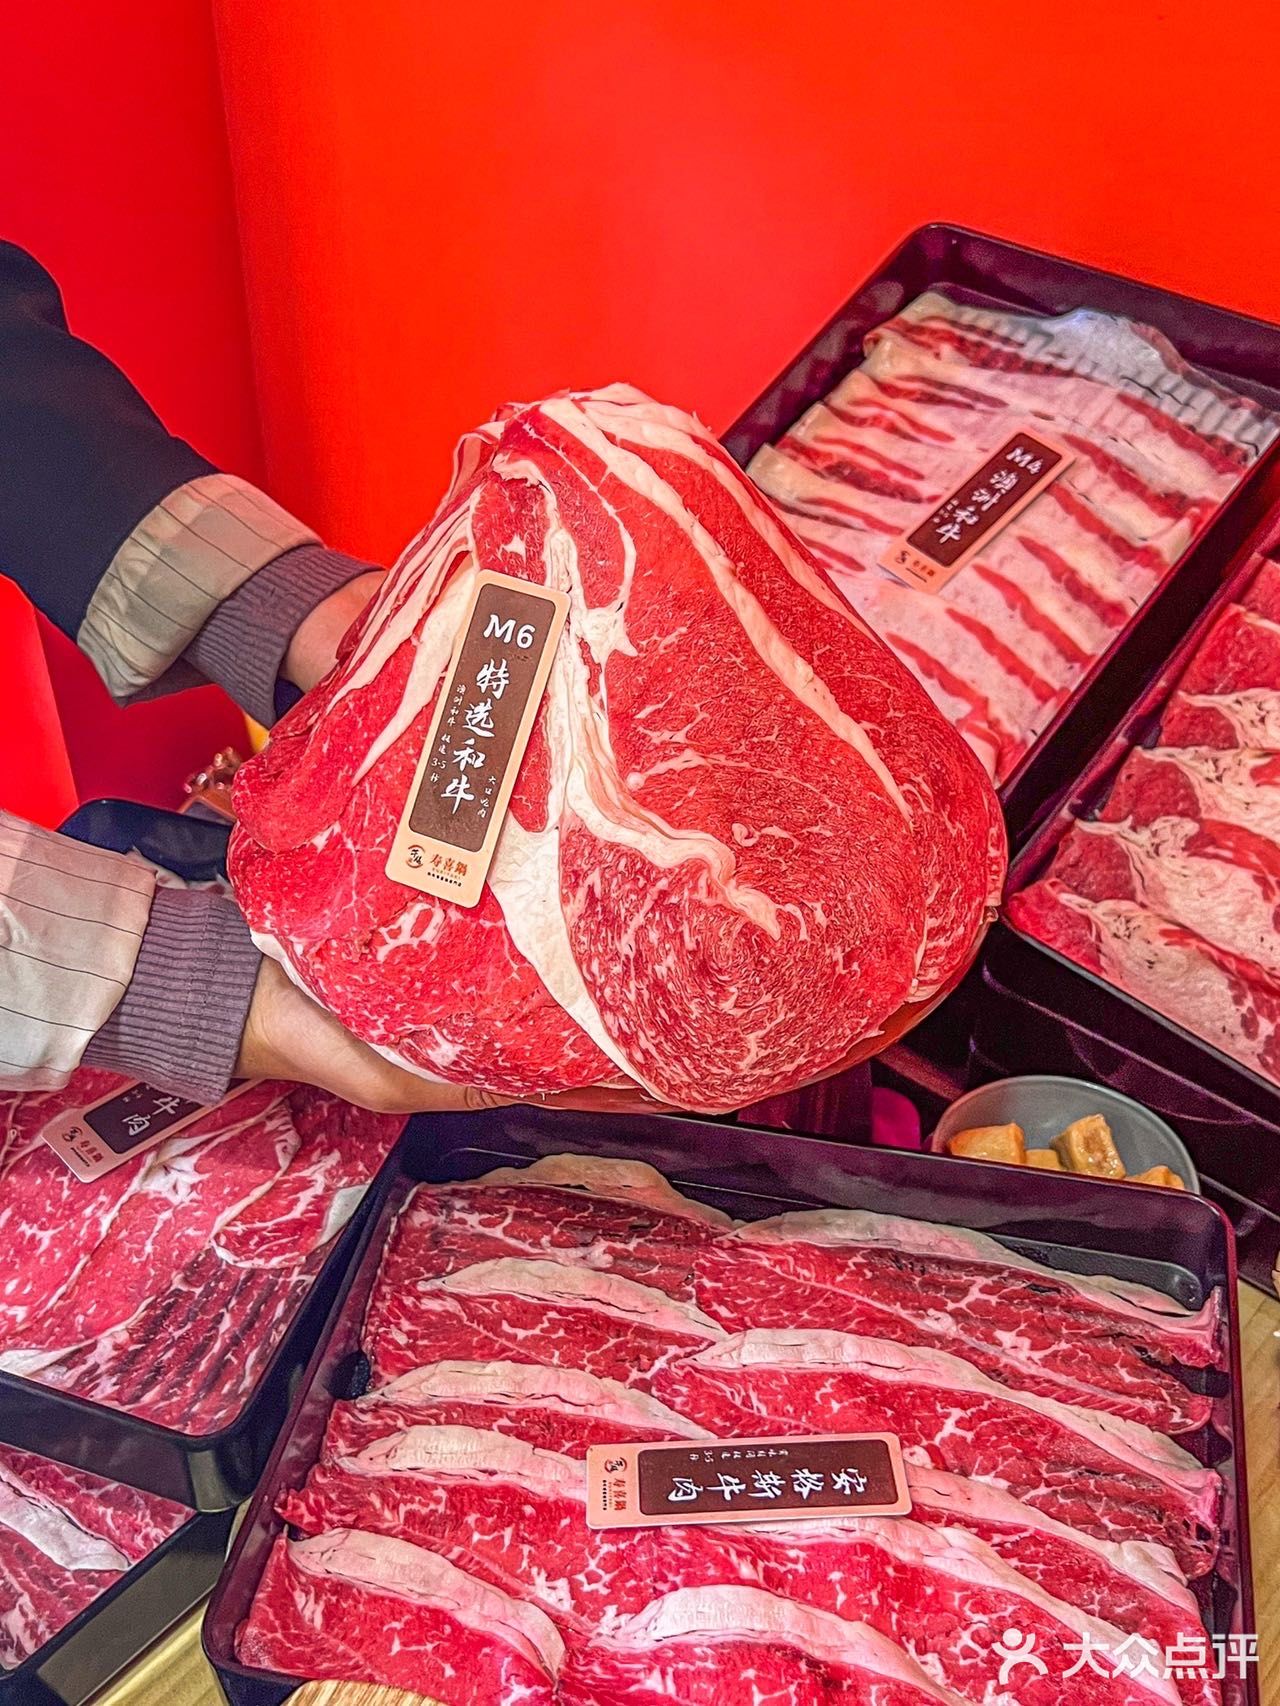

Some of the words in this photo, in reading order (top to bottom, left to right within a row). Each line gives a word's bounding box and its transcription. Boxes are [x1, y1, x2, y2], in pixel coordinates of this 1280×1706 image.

[1005, 446, 1043, 474] M4
[483, 614, 536, 649] M6
[441, 658, 511, 815] 特选和牛
[668, 1468, 868, 1502] 安格斯牛肉
